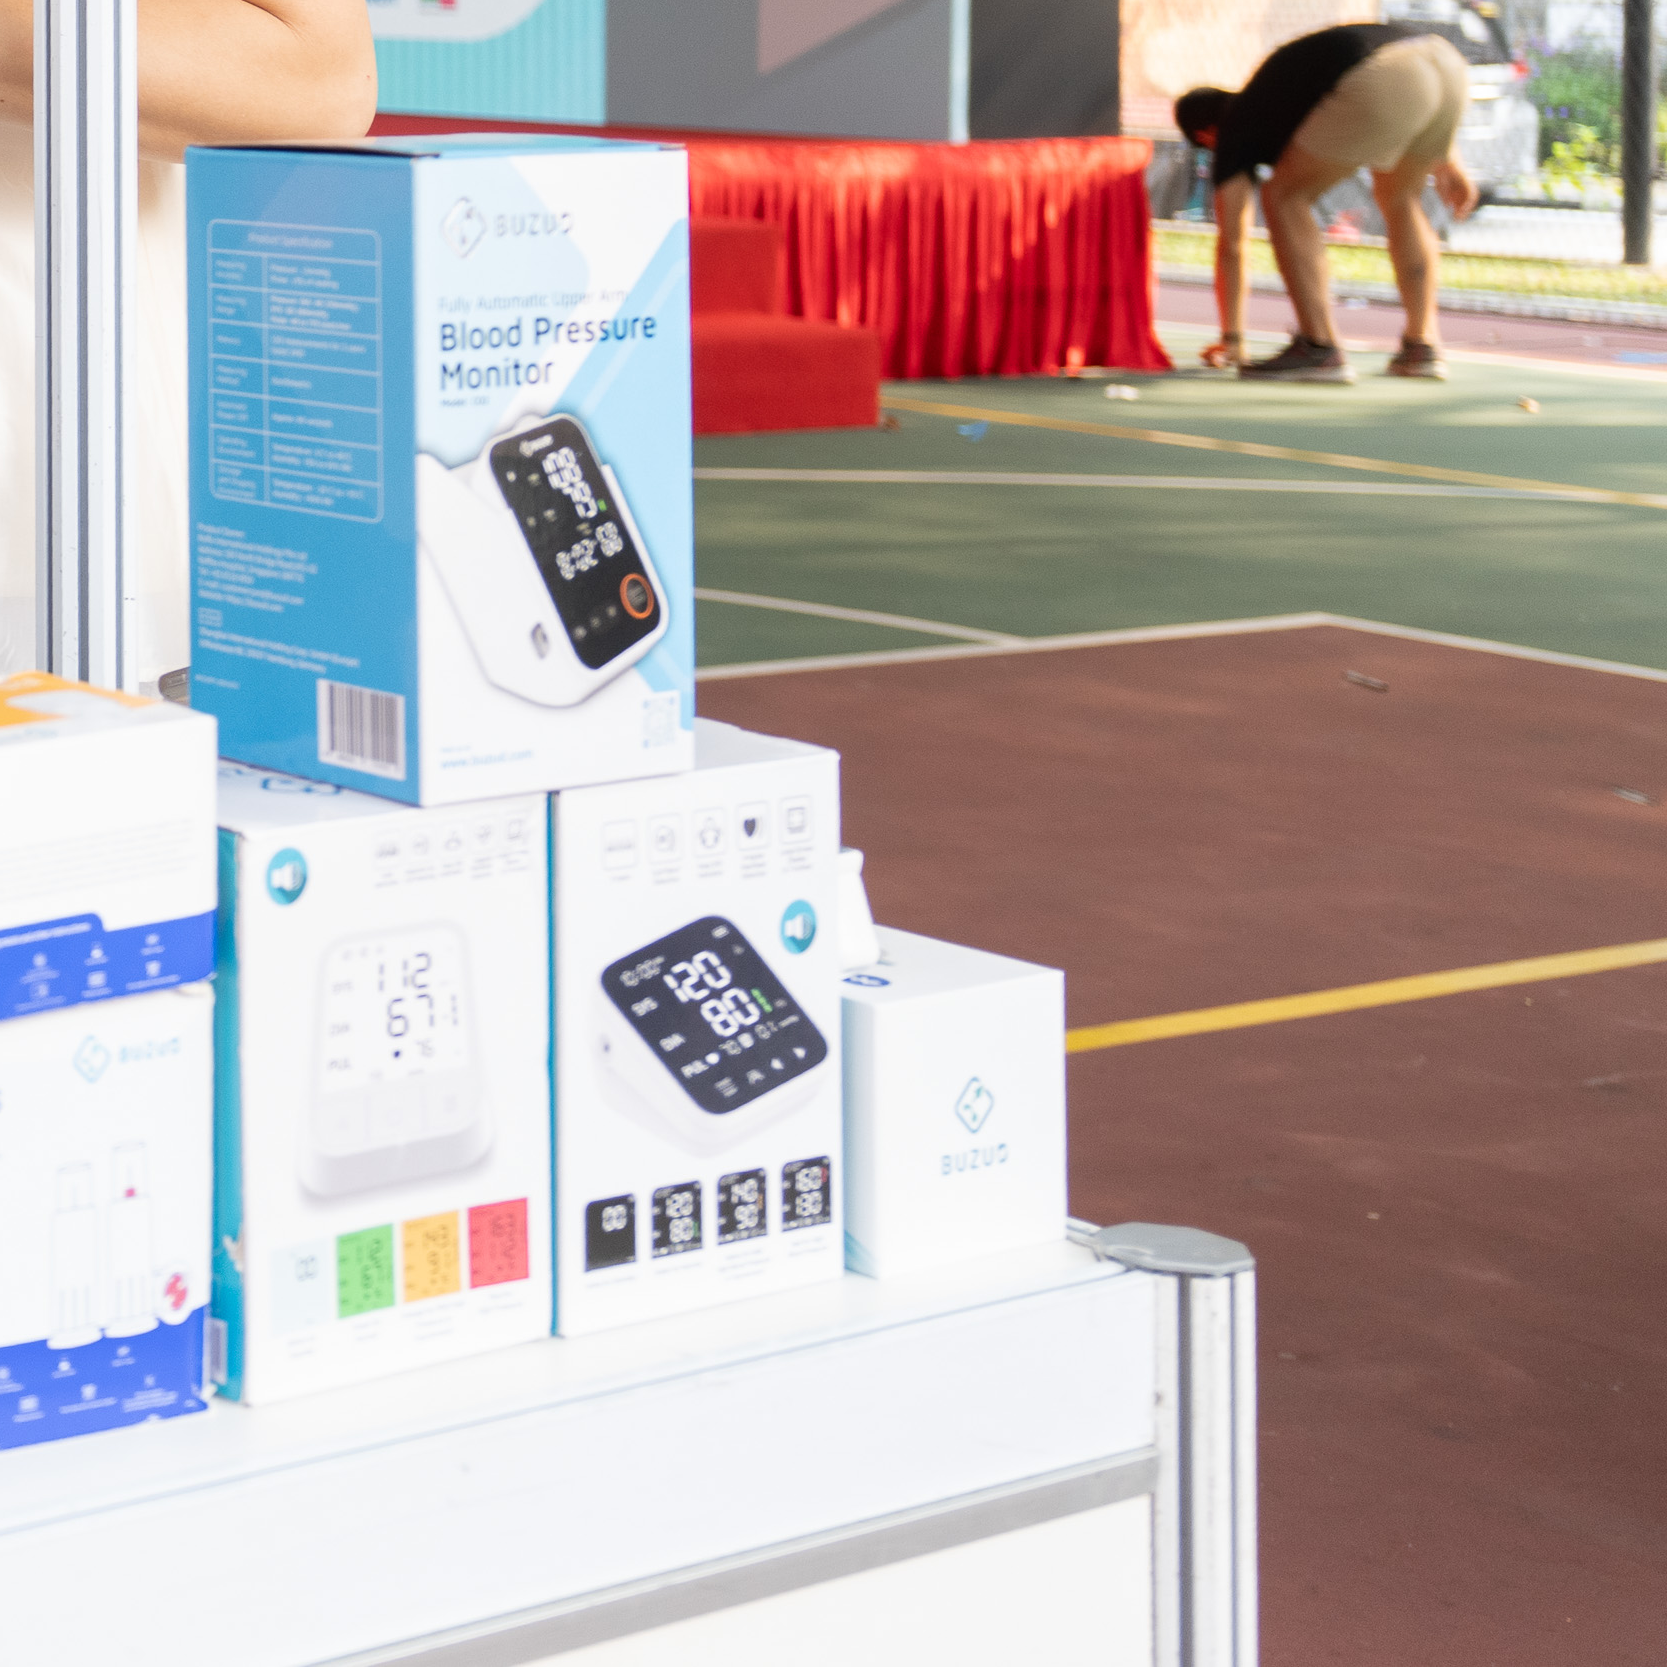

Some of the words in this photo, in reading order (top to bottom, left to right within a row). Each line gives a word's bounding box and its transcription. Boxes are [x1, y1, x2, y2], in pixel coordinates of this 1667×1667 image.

[440, 317, 522, 352] Blood
[534, 315, 657, 346] Pressure
[440, 358, 555, 392] Monitor
[378, 951, 432, 992] 112
[663, 950, 733, 1004] 120
[387, 994, 435, 1038] 67
[700, 988, 761, 1038] 80
[939, 1142, 1010, 1176] BUZUD
